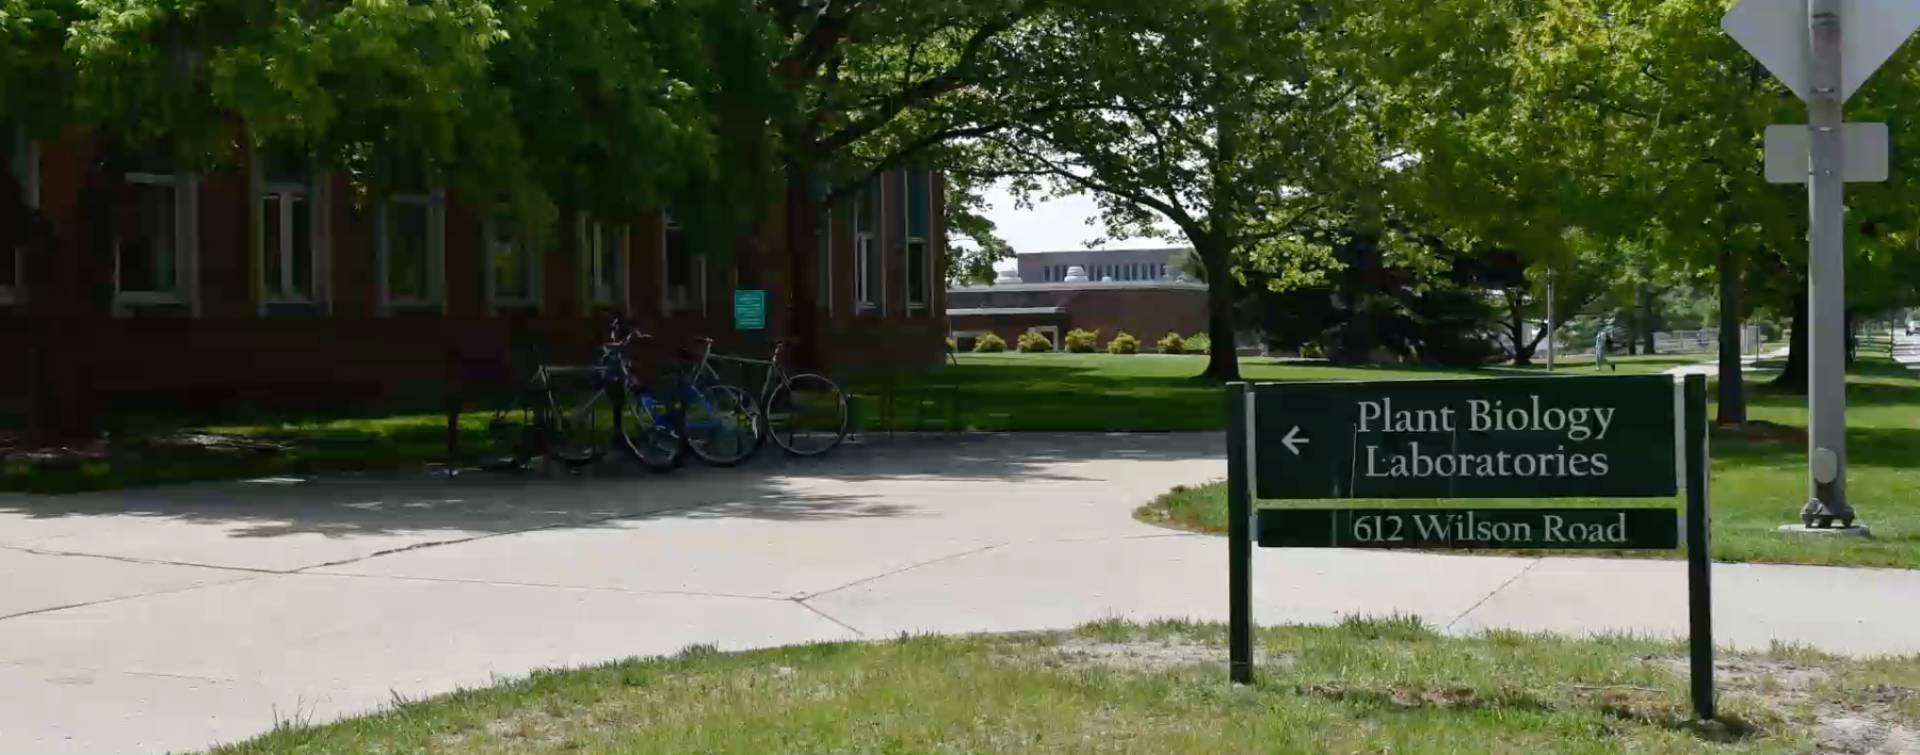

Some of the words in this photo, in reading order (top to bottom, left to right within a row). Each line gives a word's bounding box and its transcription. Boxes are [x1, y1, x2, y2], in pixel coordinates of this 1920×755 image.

[1357, 397, 1456, 433] Plant
[1466, 395, 1615, 441] Biology
[1365, 442, 1609, 477] Laboratories
[1354, 515, 1404, 542] 612
[1412, 511, 1531, 542] Wilson
[1542, 512, 1627, 543] Road
